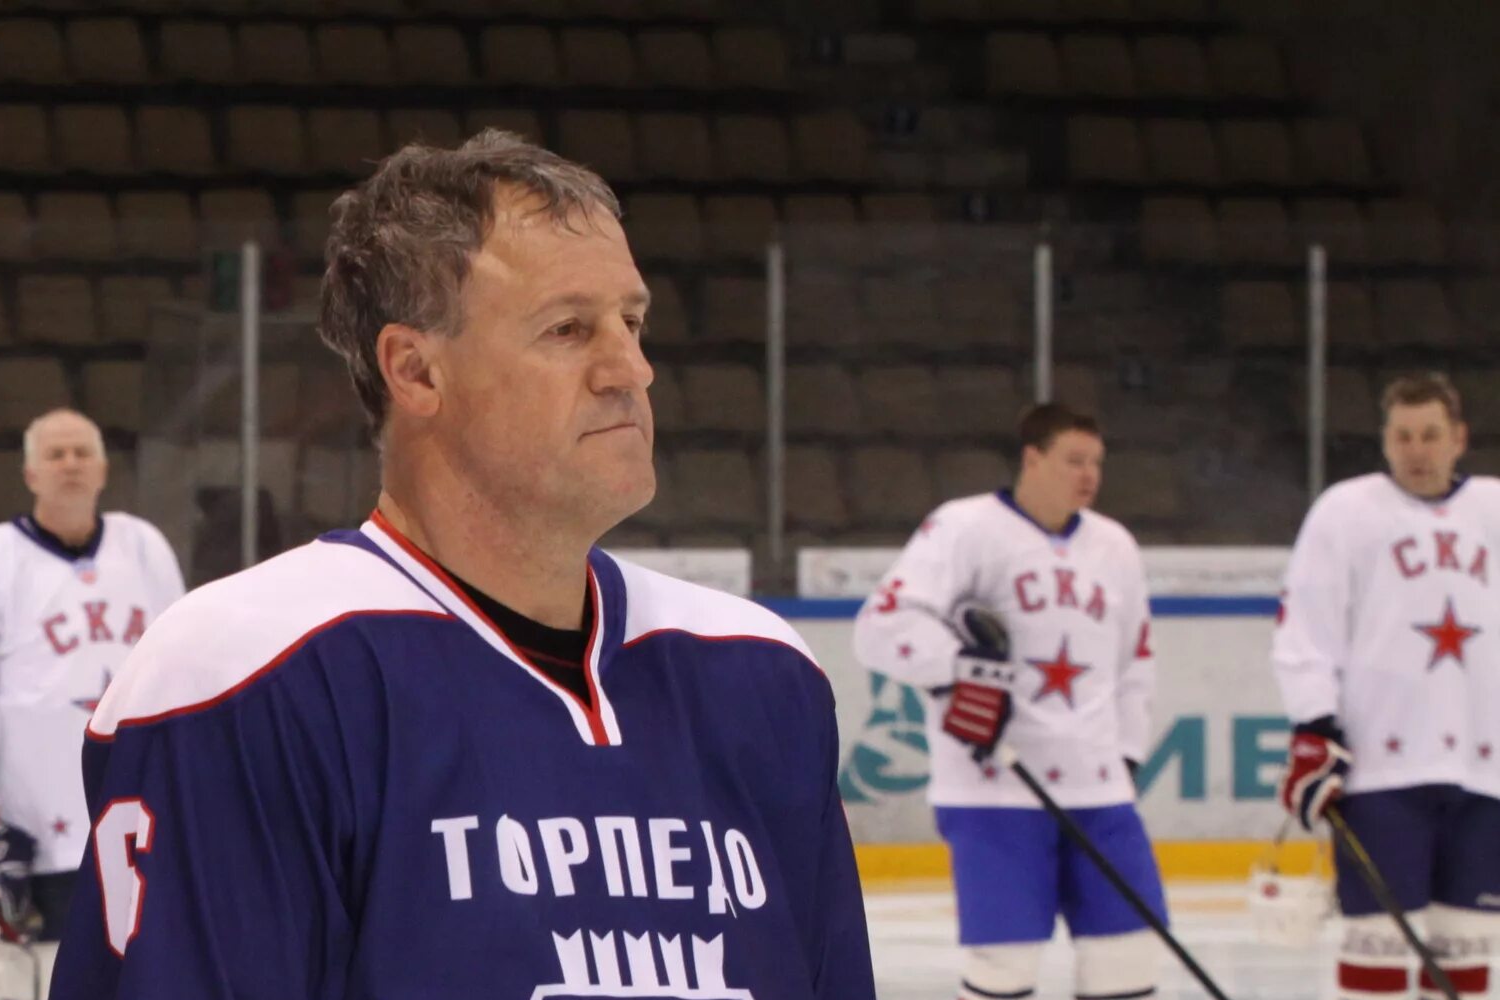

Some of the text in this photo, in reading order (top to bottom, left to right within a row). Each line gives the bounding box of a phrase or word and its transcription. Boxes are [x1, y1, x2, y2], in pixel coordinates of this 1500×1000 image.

[1392, 532, 1488, 587] СКА
[1014, 568, 1107, 621] СКА
[43, 601, 146, 655] СКА
[431, 814, 767, 919] ТОРПЕДО
